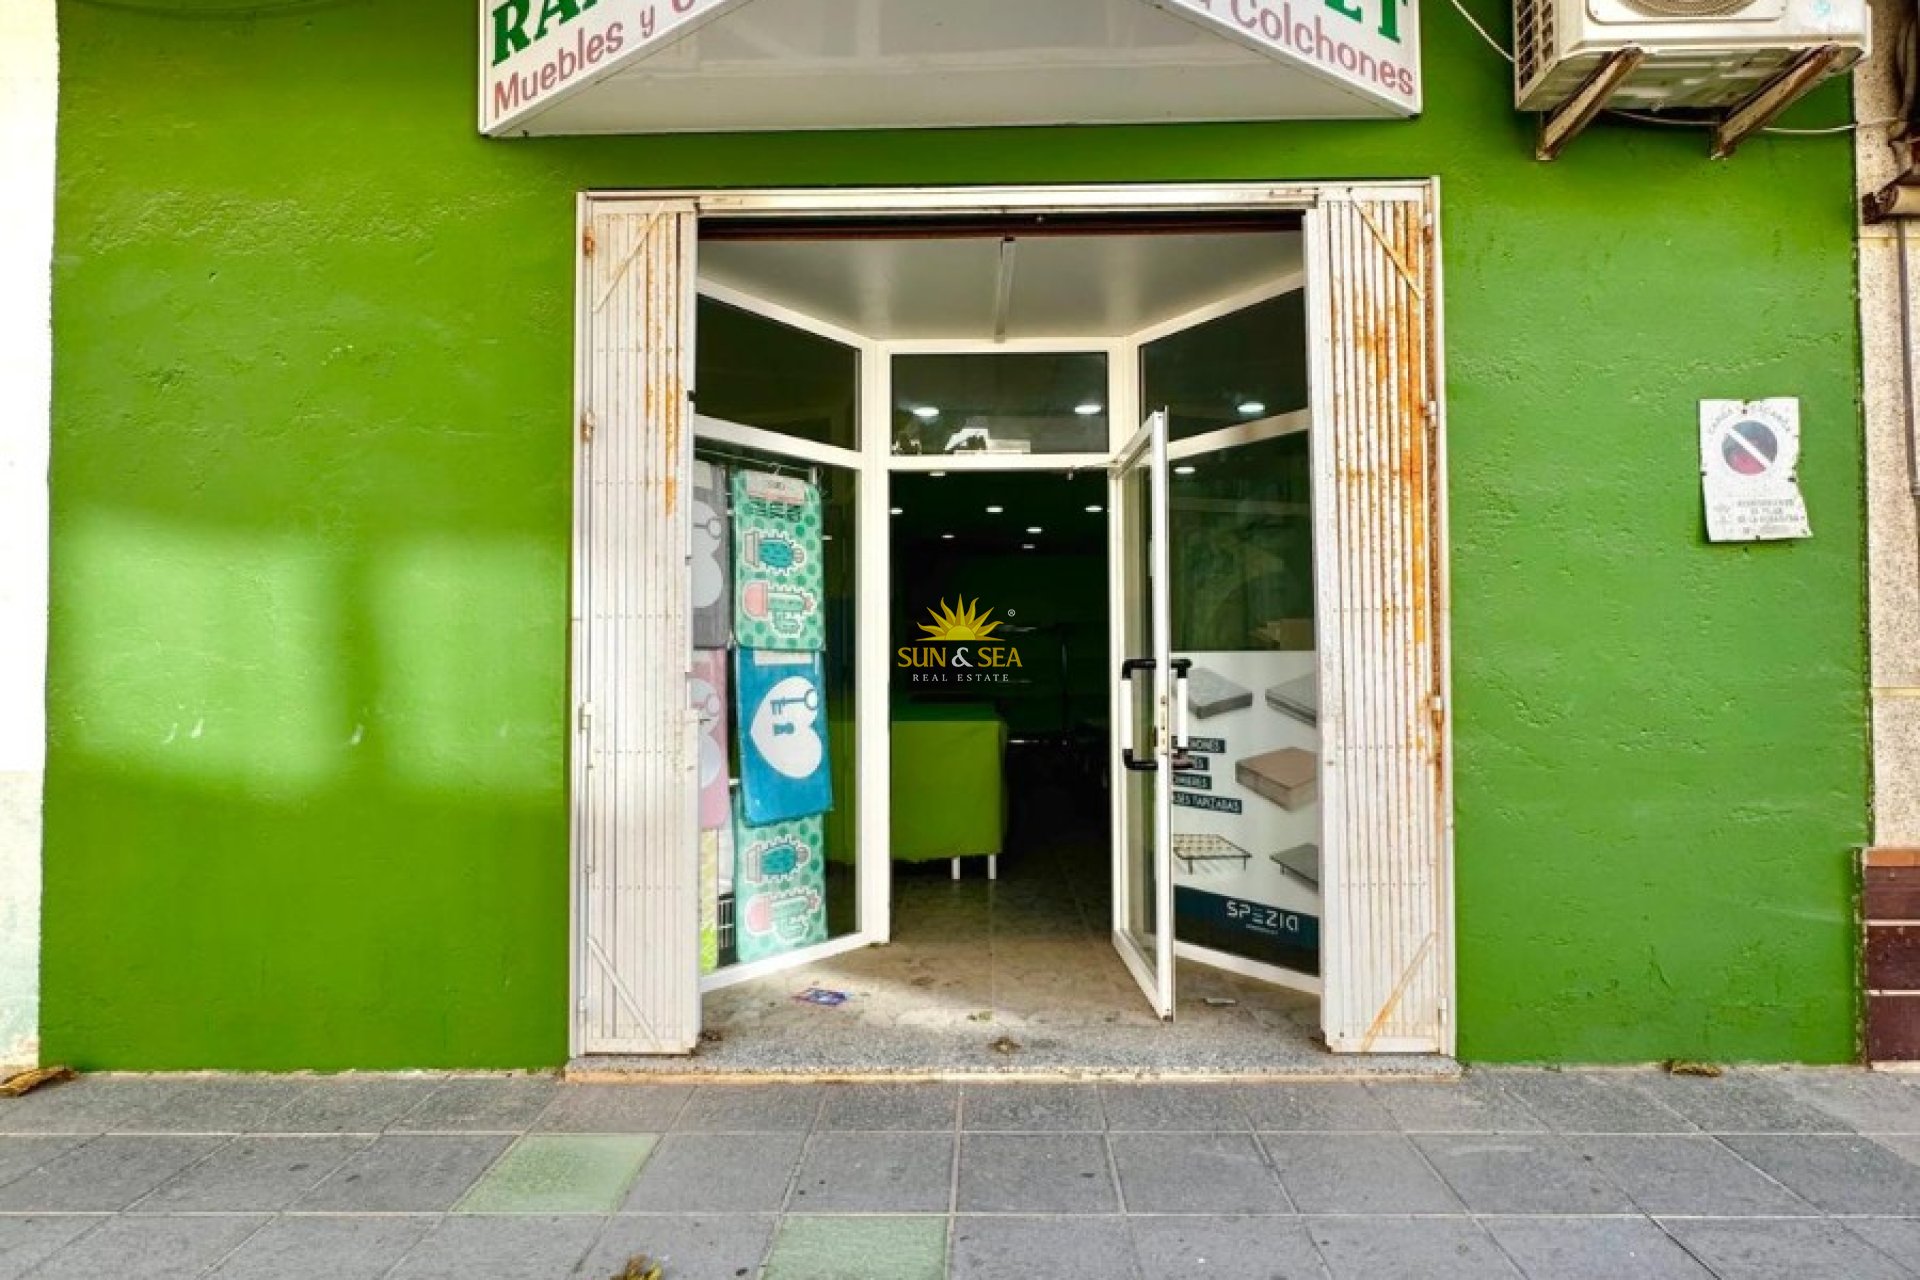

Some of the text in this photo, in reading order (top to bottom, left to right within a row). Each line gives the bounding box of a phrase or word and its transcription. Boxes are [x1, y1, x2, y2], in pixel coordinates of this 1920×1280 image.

[494, 6, 655, 119] Muebles y
[1230, 0, 1414, 96] Colchones
